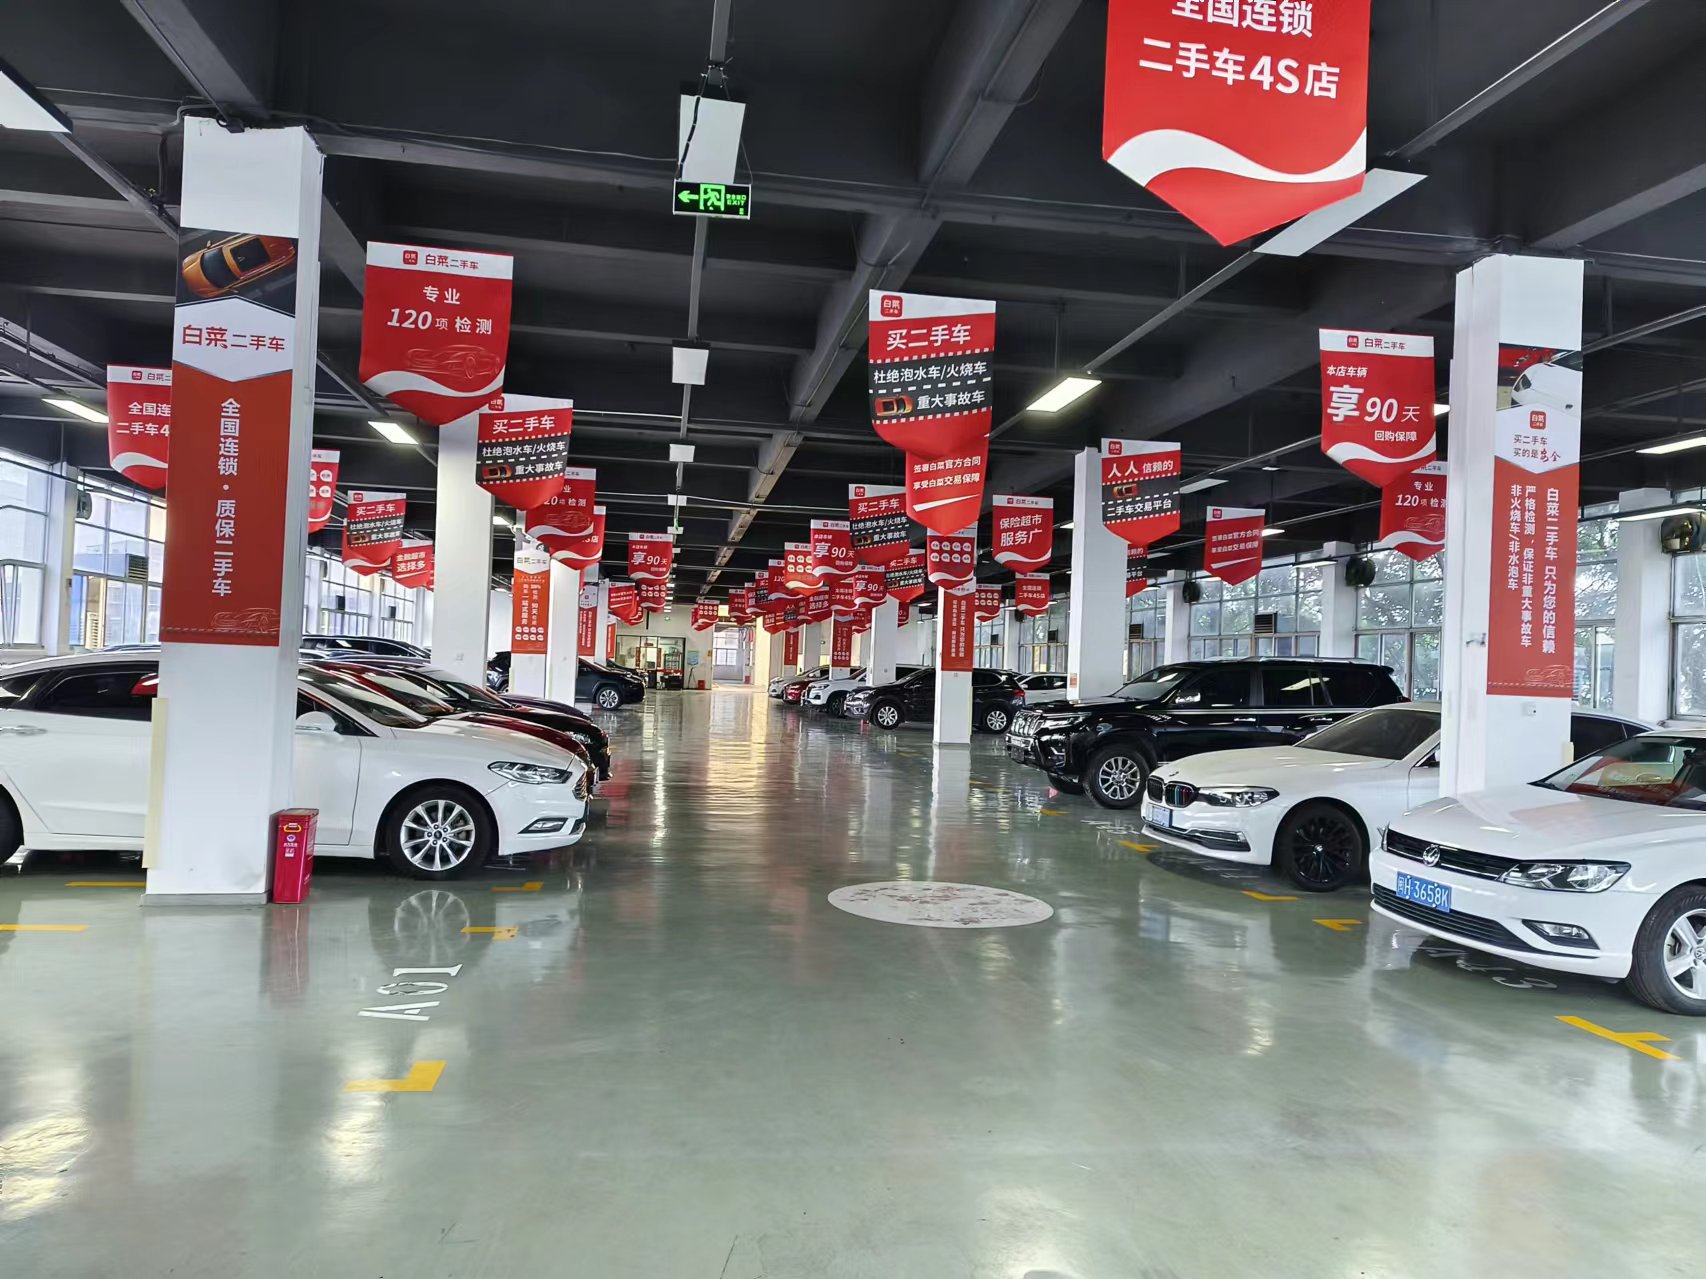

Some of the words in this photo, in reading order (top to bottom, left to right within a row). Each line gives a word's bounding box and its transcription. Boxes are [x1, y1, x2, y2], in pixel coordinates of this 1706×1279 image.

[1172, 0, 1313, 38] 全国连锁
[1139, 37, 1341, 99] 二手车4S店
[423, 285, 460, 306] 专业
[182, 325, 286, 353] 白菜二手车
[886, 324, 971, 350] 买二手车
[873, 361, 987, 384] 杜绝泡水车/火烧车
[1327, 364, 1368, 379] 本店车辆
[917, 390, 985, 410] 重大事故车
[1327, 385, 1420, 424] 享90天
[492, 415, 555, 434] 买二手车
[1374, 429, 1418, 443] 回购保障
[1513, 433, 1548, 446] 买二手车
[482, 441, 567, 458] 杜绝泡水车/火烧车
[515, 461, 564, 476] 重大事故车
[356, 503, 396, 517] 买二手车
[857, 498, 900, 514] 买二手车
[1107, 497, 1173, 518] 二手车交易平台
[999, 515, 1042, 530] 保险超市
